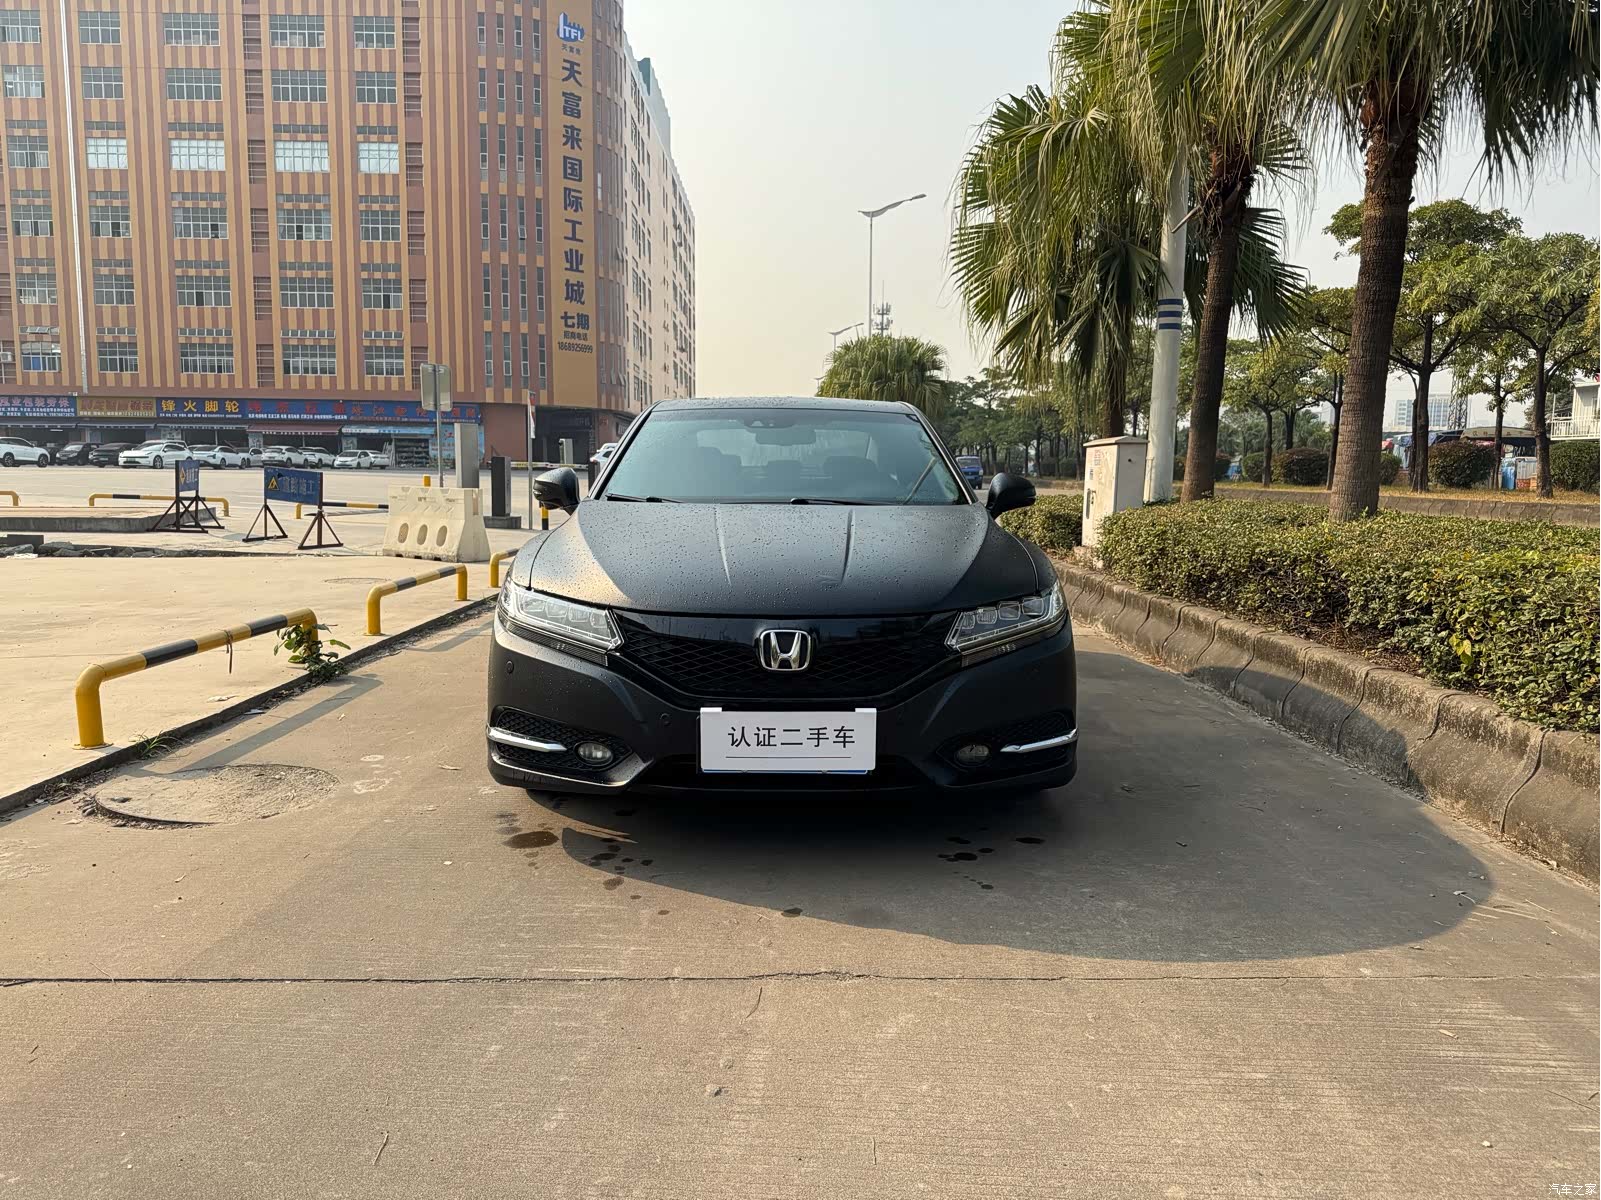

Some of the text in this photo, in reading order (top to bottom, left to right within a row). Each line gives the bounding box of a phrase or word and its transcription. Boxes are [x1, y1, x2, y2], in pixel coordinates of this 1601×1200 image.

[561, 57, 585, 306] 天富来国际工业城
[560, 311, 590, 331] 七期
[161, 399, 240, 413] 锋火脚轮
[728, 725, 856, 749] 认证二手车
